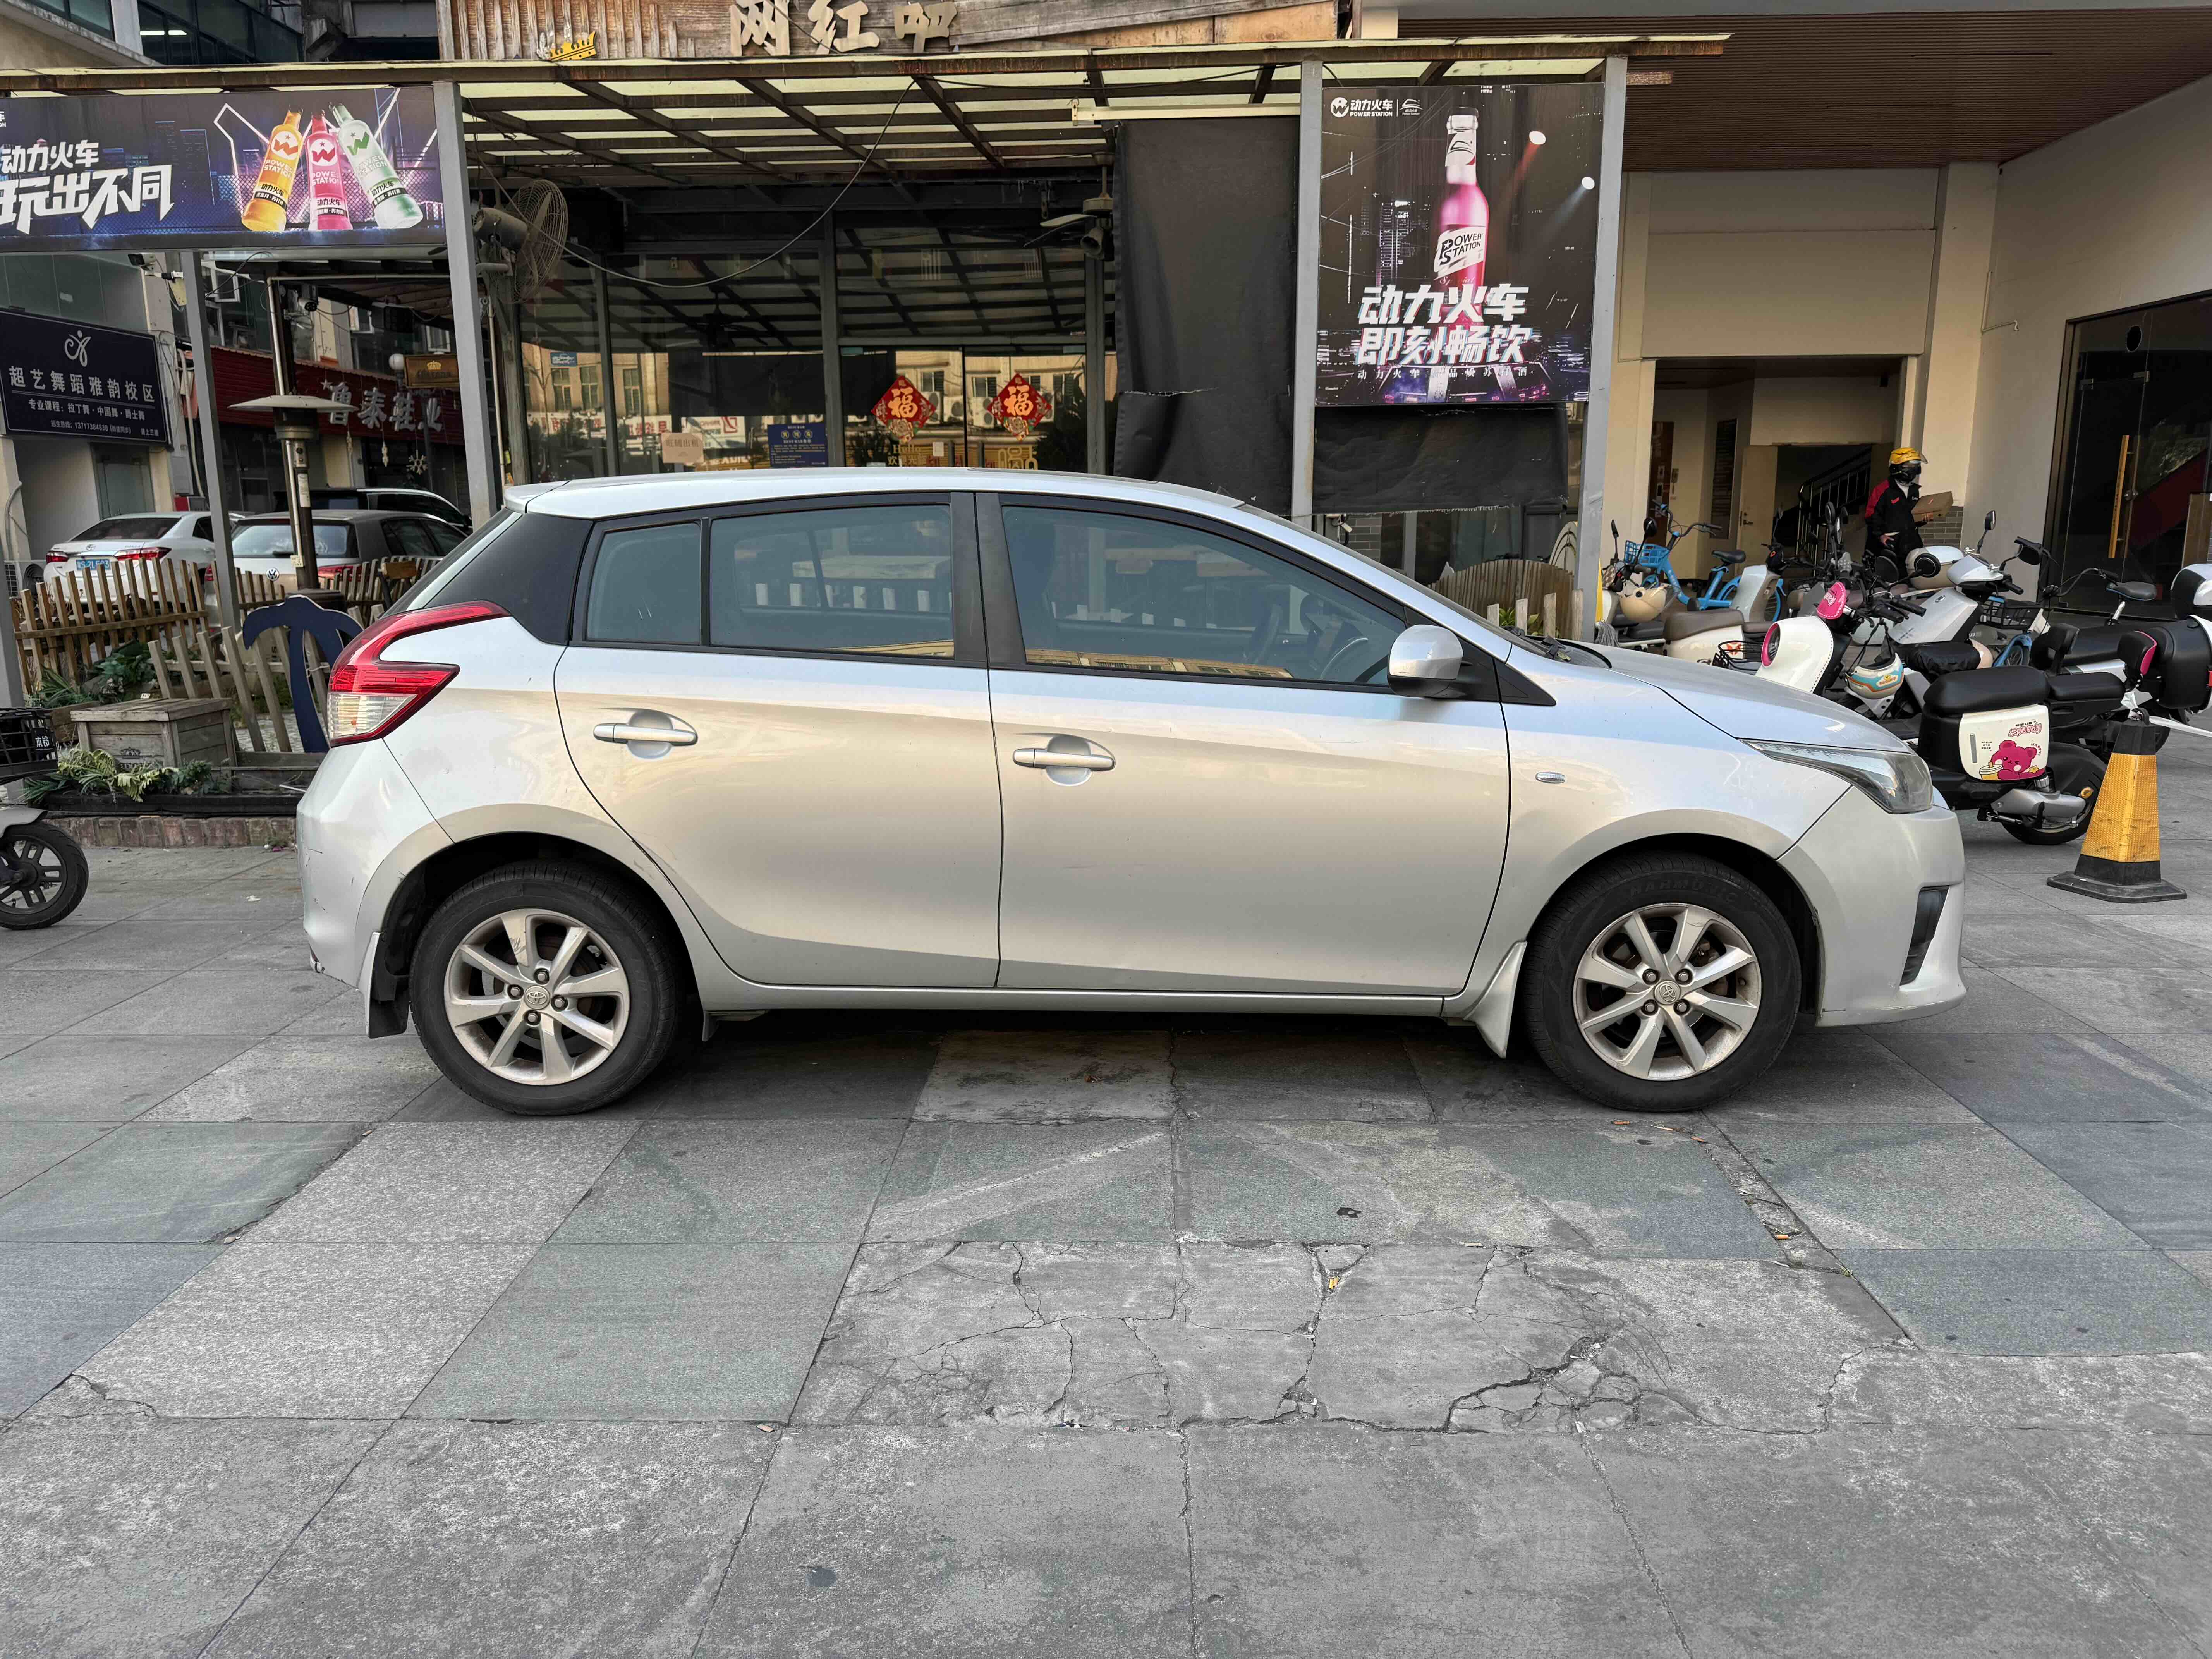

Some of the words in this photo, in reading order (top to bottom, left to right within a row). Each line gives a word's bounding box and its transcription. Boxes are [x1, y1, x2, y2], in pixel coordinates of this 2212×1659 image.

[1350, 99, 1393, 111] 动力火车
[1, 140, 99, 174] 动力火车
[0, 165, 175, 235] 玩出不同
[261, 184, 284, 196] 动力火车
[371, 181, 394, 197] 动力火车
[1438, 233, 1481, 261] POWER
[1439, 241, 1481, 266] STATION
[1358, 283, 1529, 325] 动力火车
[1356, 324, 1532, 365] 即刻畅饮
[9, 365, 155, 402] 超艺舞蹈雅韵校区
[888, 387, 918, 418] 福
[1004, 385, 1034, 416] 福
